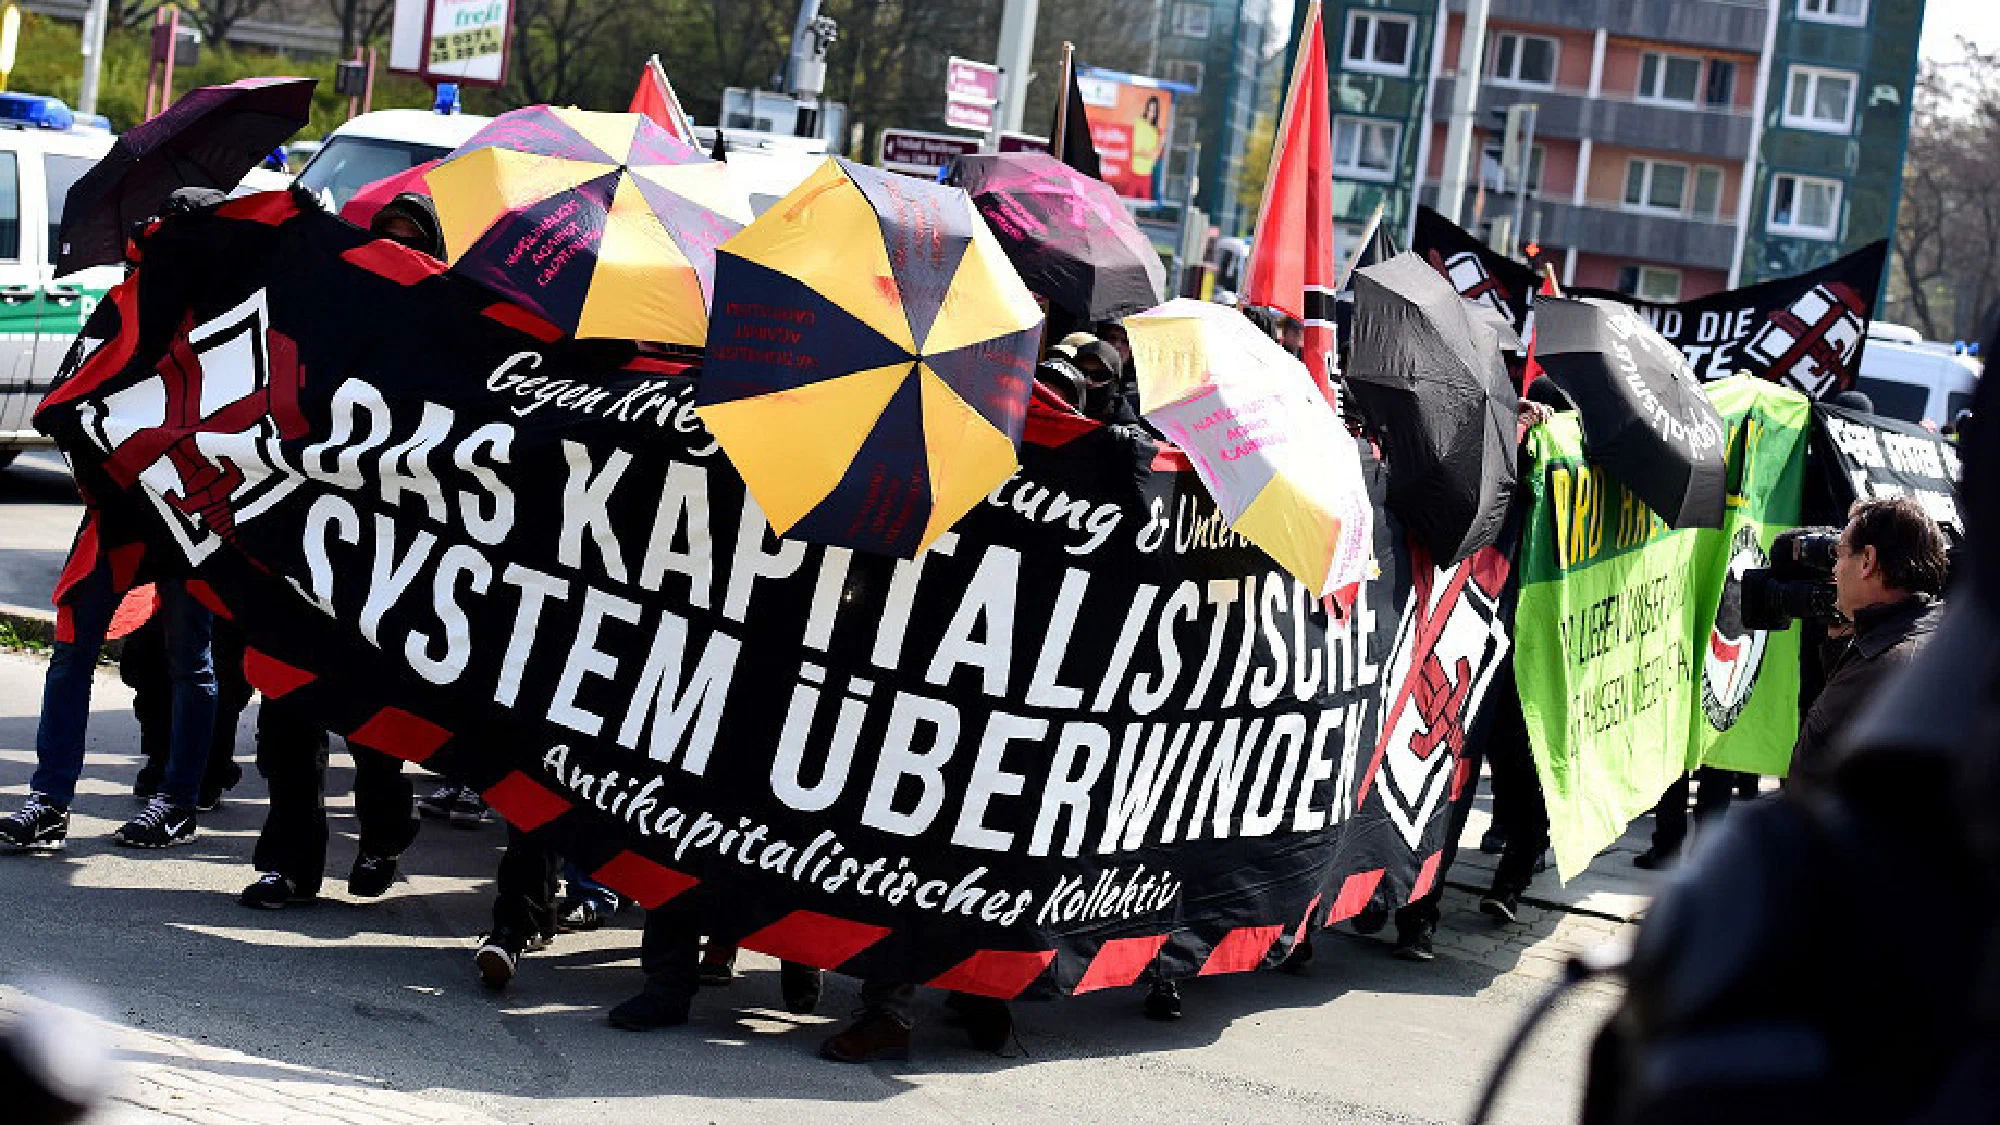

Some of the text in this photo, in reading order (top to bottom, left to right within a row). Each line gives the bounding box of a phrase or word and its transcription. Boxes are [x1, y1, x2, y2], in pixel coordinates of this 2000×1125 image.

[1682, 340, 1740, 379] TE
[1697, 307, 1756, 342] DIE
[302, 377, 1380, 714] DAS KAPITALISTISCHE
[487, 351, 612, 418] Gegen
[1136, 496, 1170, 554] &
[284, 493, 1369, 858] SYSTEM ÜBERWINDEN
[543, 743, 1182, 928] Antikapitalistisches Kollektiv
